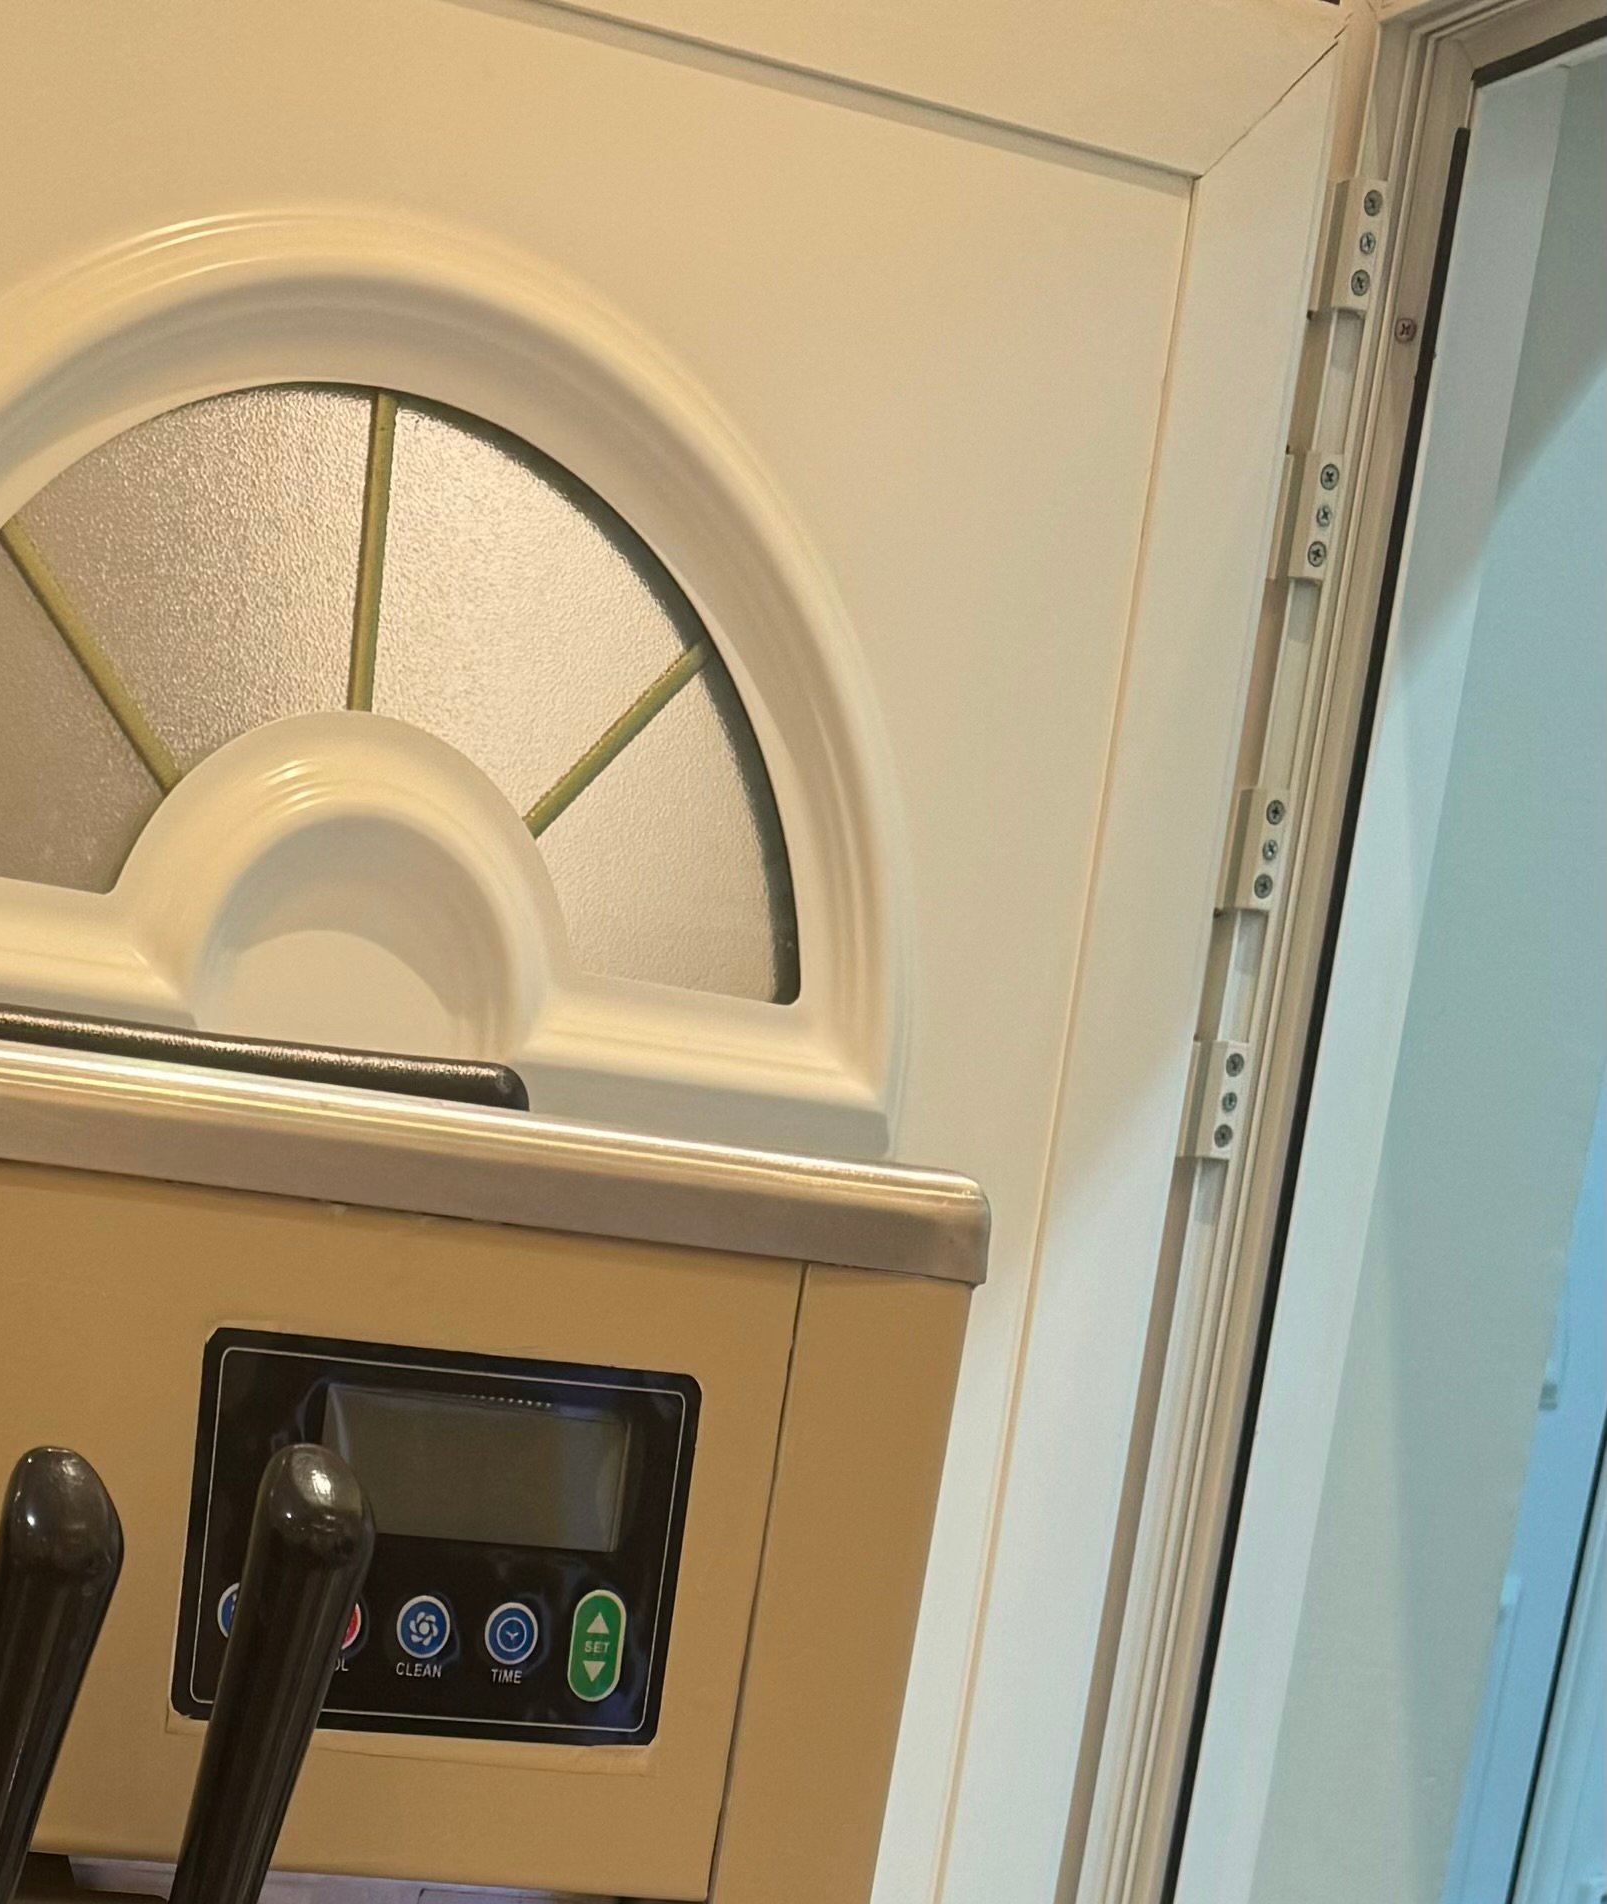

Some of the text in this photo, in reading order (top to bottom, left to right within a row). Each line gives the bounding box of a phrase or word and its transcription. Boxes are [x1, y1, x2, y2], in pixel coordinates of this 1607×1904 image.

[584, 1640, 610, 1653] SET
[395, 1661, 442, 1679] CLEAN
[491, 1668, 522, 1684] TIME
